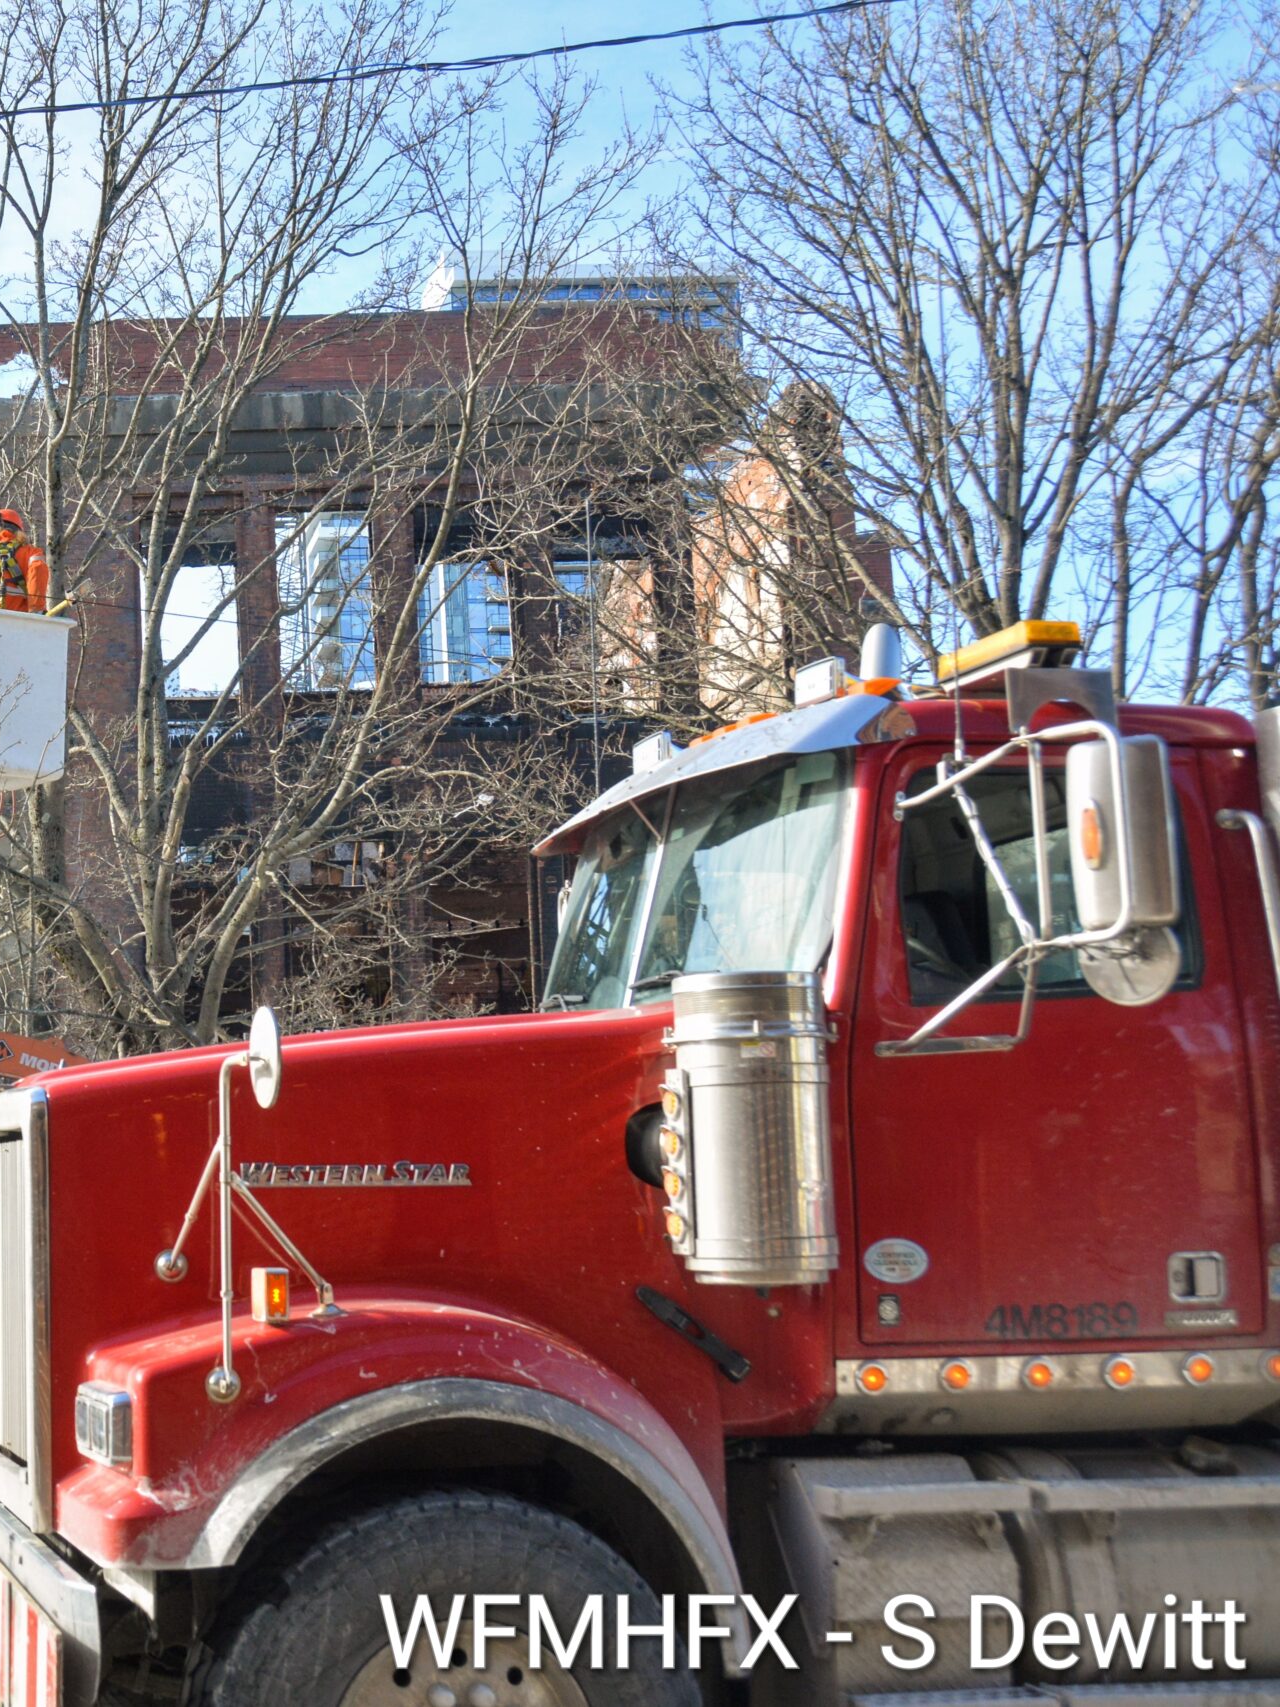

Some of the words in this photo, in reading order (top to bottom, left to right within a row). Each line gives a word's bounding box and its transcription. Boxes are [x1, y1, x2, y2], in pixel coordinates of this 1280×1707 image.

[240, 1162, 387, 1186] WESTERN
[391, 1160, 471, 1186] STAR
[984, 1302, 1137, 1339] 4M8189
